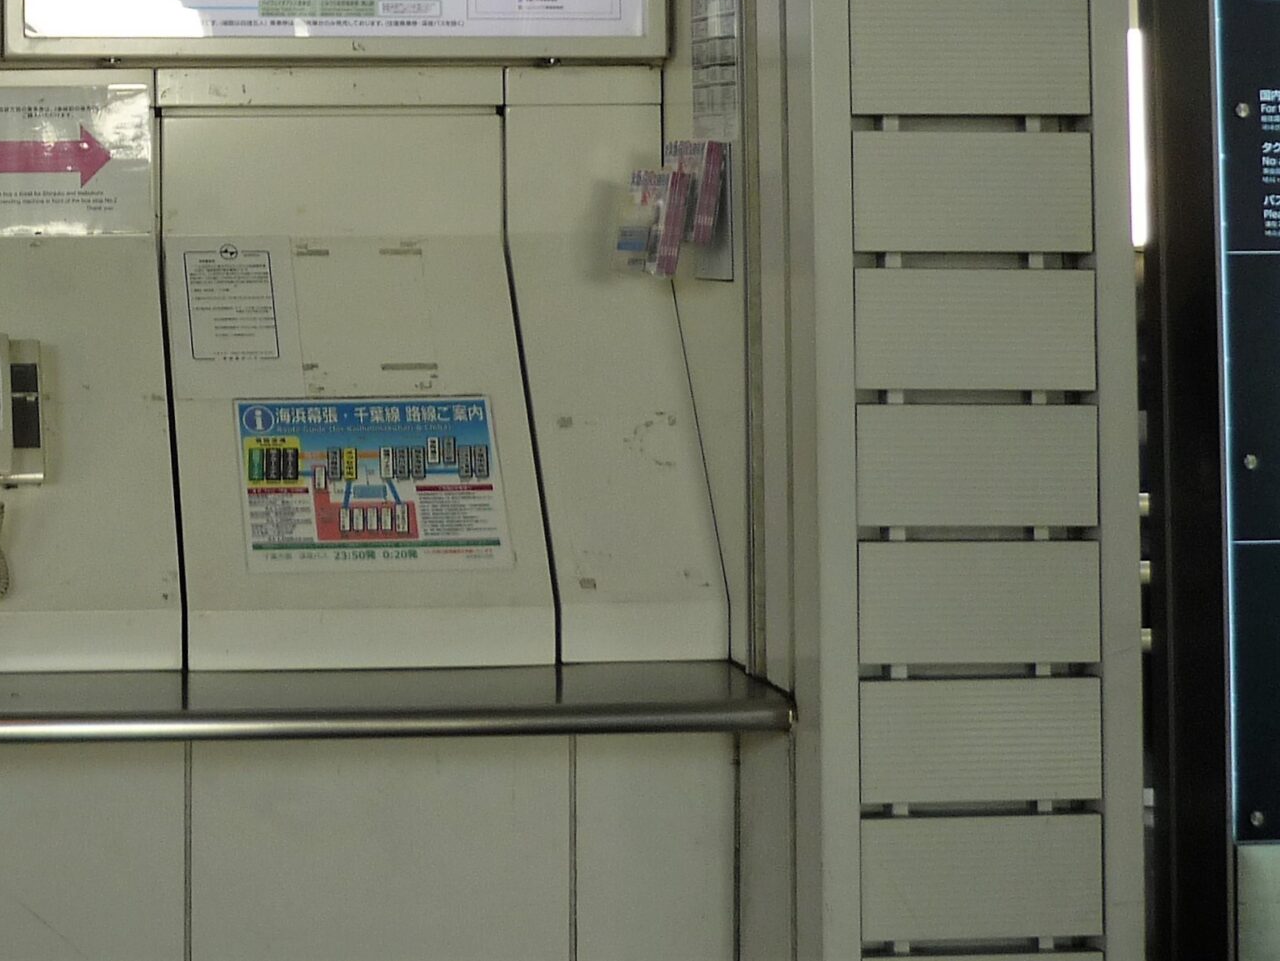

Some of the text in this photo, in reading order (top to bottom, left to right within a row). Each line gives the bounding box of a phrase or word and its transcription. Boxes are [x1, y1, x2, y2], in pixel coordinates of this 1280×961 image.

[1260, 103, 1276, 113] For
[1262, 156, 1277, 166] No
[275, 405, 485, 424] 海浜幕張・千葉線 路線ご案内
